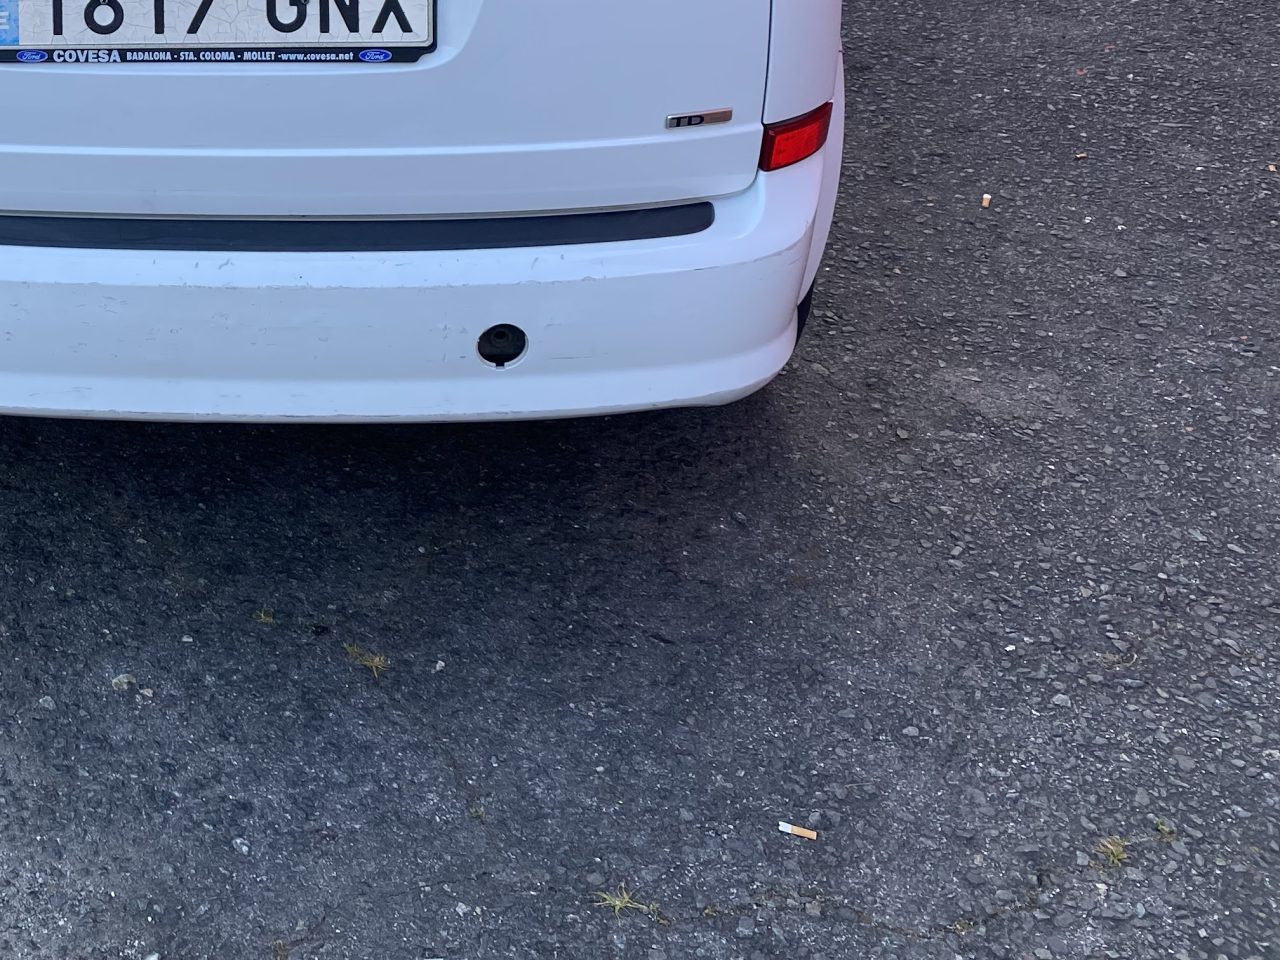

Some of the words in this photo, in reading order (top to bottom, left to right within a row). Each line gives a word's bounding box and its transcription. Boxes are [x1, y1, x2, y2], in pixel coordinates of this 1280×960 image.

[52, 50, 122, 63] COVESA
[126, 51, 172, 61] BADALONA
[179, 51, 197, 61] STA.
[199, 51, 235, 61] COLOMA
[243, 51, 276, 61] MOLLET
